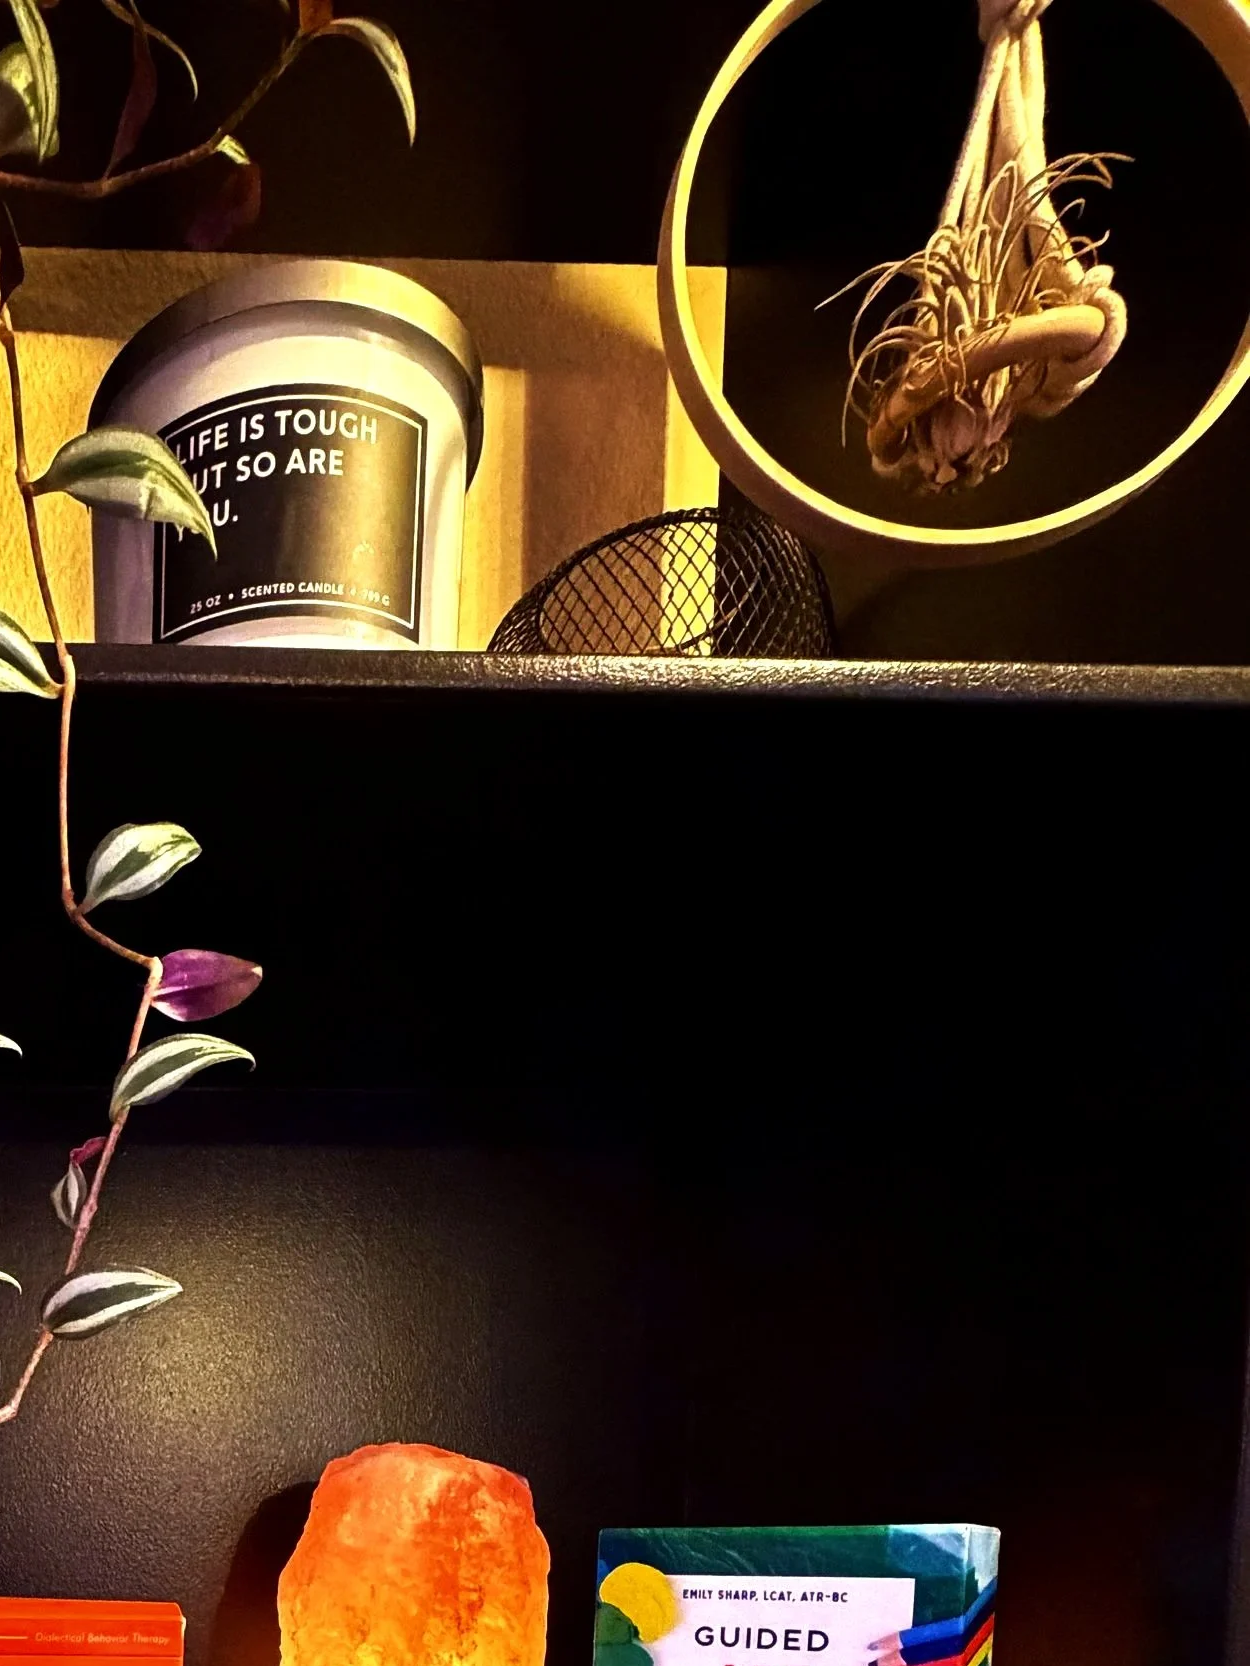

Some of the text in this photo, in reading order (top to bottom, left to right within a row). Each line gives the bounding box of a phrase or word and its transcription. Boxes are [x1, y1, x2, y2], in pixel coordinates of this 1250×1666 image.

[175, 408, 378, 465] LIFE IS TOUGH
[235, 448, 344, 483] SO ARE
[190, 581, 345, 614] 25 OZ SCENTED CANDLE
[682, 1588, 849, 1604] EMILY SHARP, LCAT, ATR-BC
[35, 1631, 170, 1646] Dialectical Behavior Therapy
[694, 1626, 830, 1652] GUIDED
